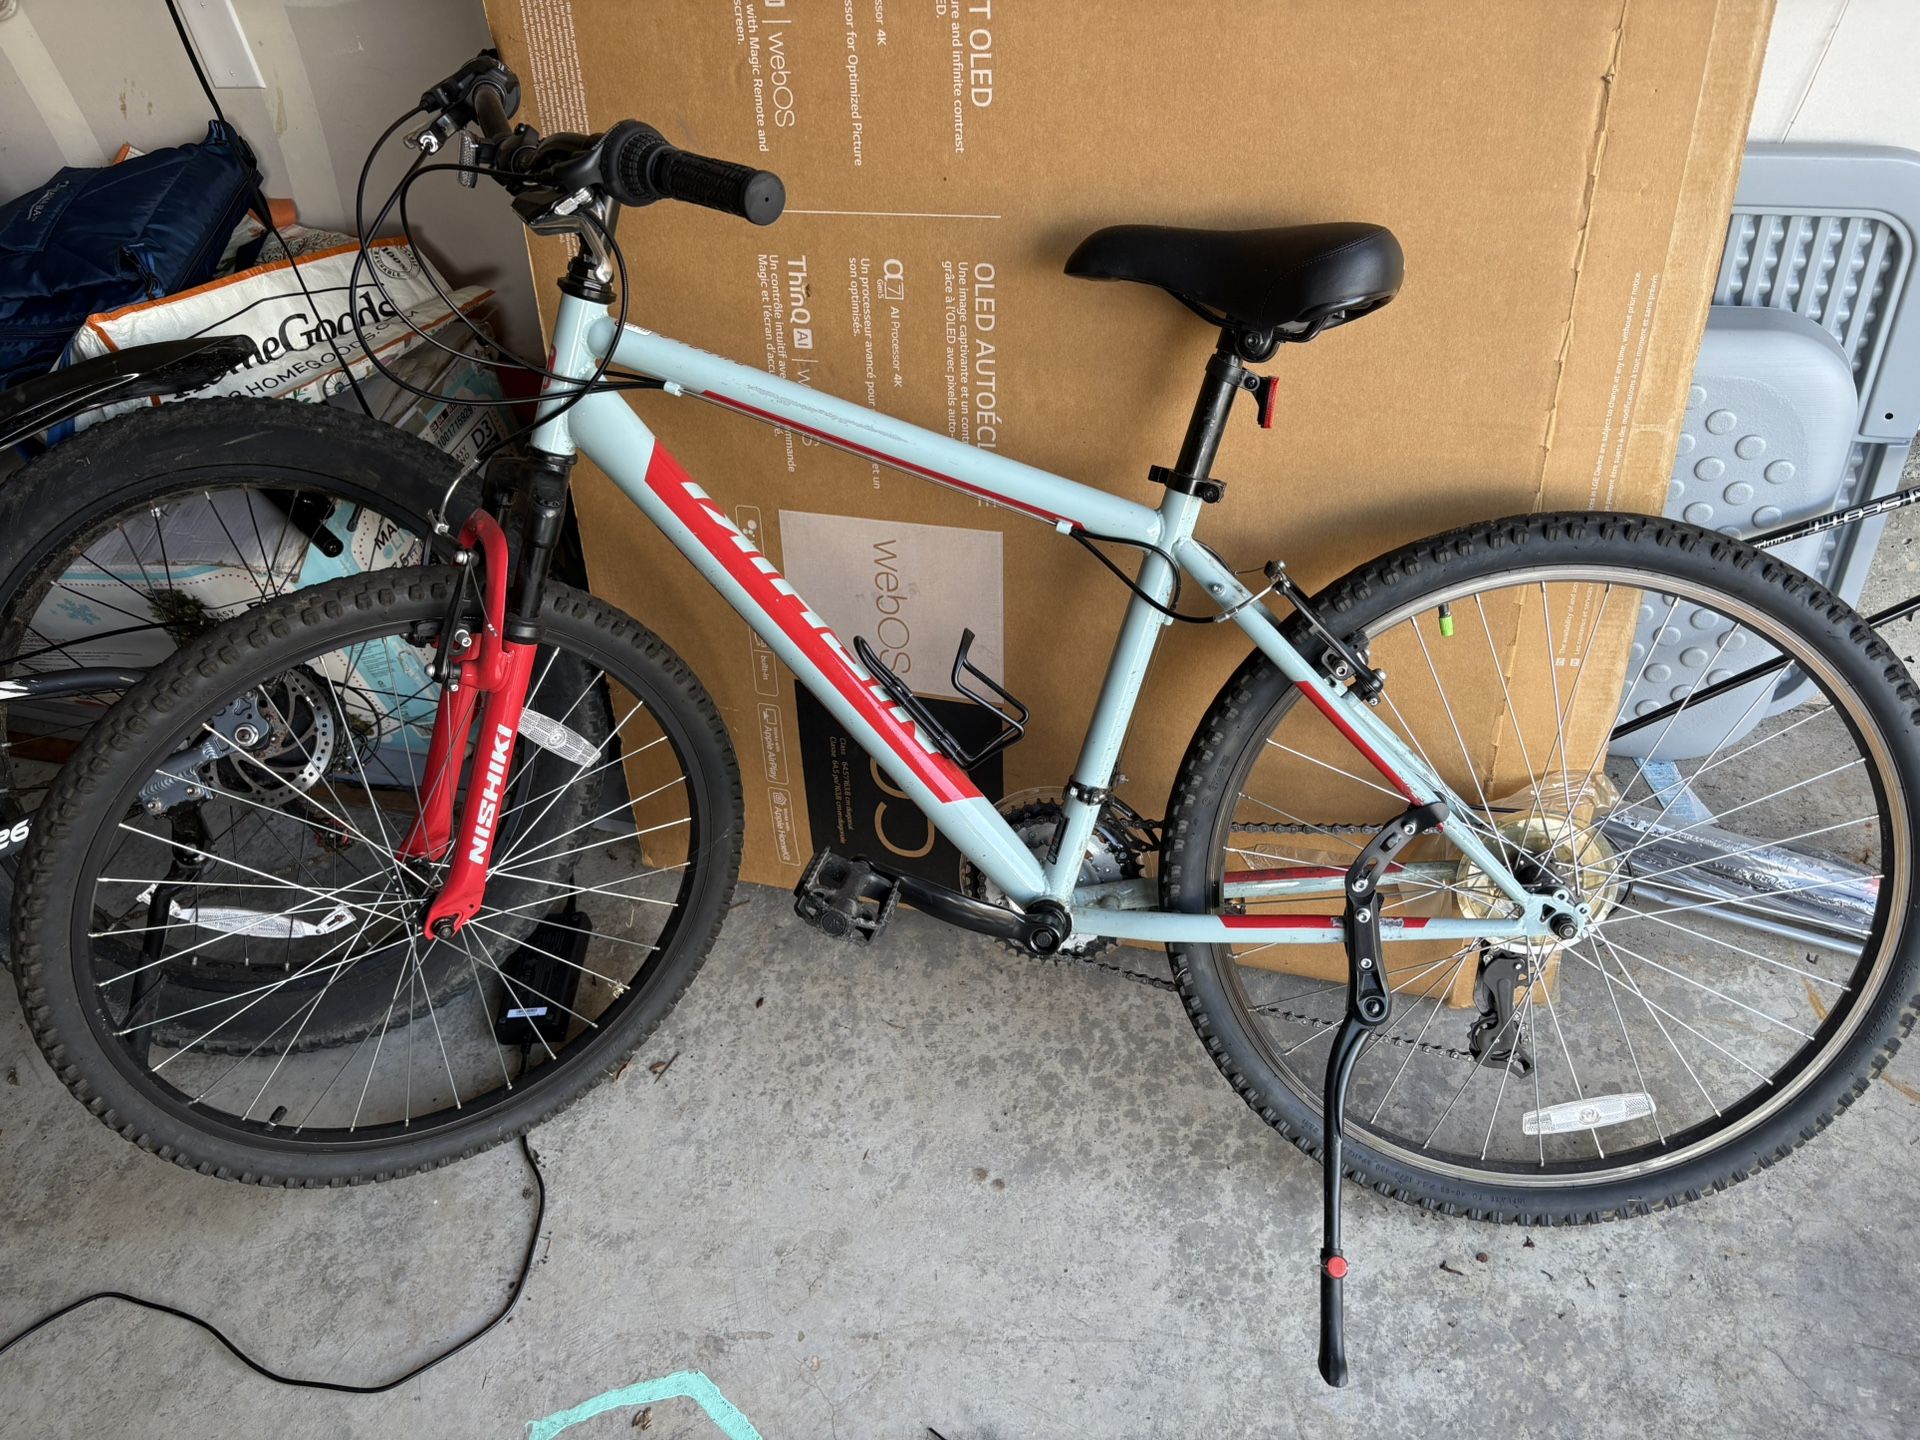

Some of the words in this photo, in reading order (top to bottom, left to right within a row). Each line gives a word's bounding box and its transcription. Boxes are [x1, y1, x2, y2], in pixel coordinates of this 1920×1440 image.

[746, 4, 757, 33] with
[951, 22, 963, 47] and
[846, 32, 858, 51] for
[877, 29, 887, 46] 4K
[748, 37, 762, 75] Magic
[969, 28, 993, 108] OLED
[768, 32, 795, 127] webOS
[845, 54, 862, 119] Optimized
[952, 50, 964, 97] infinite
[753, 79, 764, 126] Remote
[757, 129, 769, 152] and
[953, 99, 965, 153] contrast
[852, 122, 863, 166] Picture
[756, 254, 769, 287] Magic
[769, 254, 778, 270] Un
[848, 257, 857, 278] son
[860, 258, 870, 274] Un
[942, 260, 954, 293] grâce
[958, 262, 968, 285] Une
[760, 290, 768, 301] et
[771, 273, 784, 319] contrôle
[787, 255, 811, 324] ThinQ
[956, 287, 969, 322] image
[974, 262, 995, 331] OLED
[762, 305, 773, 340] l'écran
[848, 281, 861, 337] optimisés.
[859, 277, 872, 338] processeur
[890, 306, 900, 318] AI
[775, 322, 787, 358] intuitif
[945, 306, 956, 344] l'OLED
[864, 340, 876, 379] avancé
[890, 321, 900, 371] Processor
[946, 347, 954, 372] avec
[957, 325, 970, 384] captivante
[864, 381, 876, 407] pour
[893, 373, 902, 388] 4K
[944, 375, 956, 406] pixels
[960, 386, 970, 398] et
[961, 401, 969, 414] un
[471, 419, 494, 450] D3
[872, 463, 881, 474] et
[873, 477, 880, 489] un
[1804, 495, 1902, 536] SCOTT
[873, 540, 911, 674] webOS
[763, 725, 775, 750] Apple
[766, 751, 779, 780] AirPlay
[468, 723, 513, 865] NISHIKI
[774, 806, 785, 829] Apple
